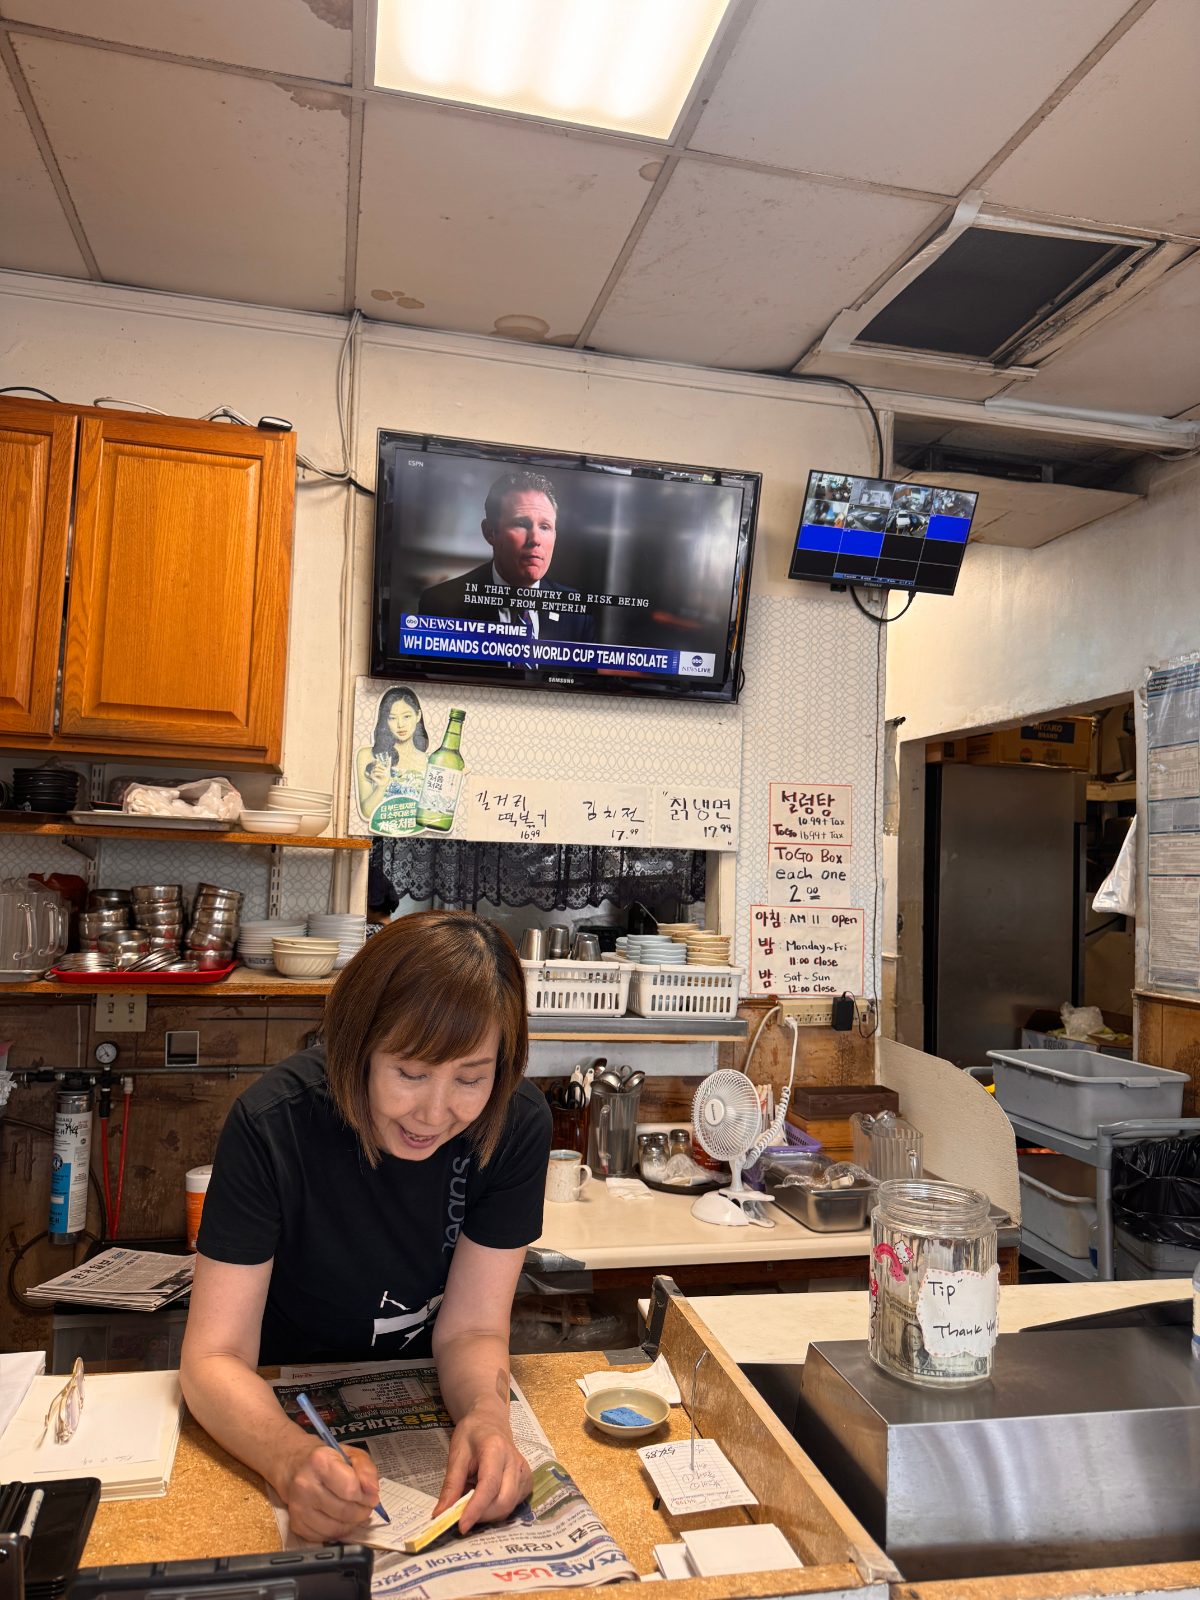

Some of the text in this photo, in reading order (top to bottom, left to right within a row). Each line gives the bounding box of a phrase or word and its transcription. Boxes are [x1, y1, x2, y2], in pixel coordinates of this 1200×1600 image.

[465, 583, 649, 608] IN THAT COUNTRY OR RISK BEING
[464, 595, 587, 614] BANNED FROM ENTERIN
[488, 623, 527, 637] PRIME
[403, 634, 422, 650] WH
[425, 637, 479, 654] DEMANDS
[481, 642, 531, 657] CONGO'S
[532, 645, 570, 661] WORLD
[573, 650, 595, 664] CUP
[597, 651, 625, 666] TEAM
[627, 654, 668, 669] ISOLATE
[548, 676, 574, 685] SAMSUNG
[781, 790, 835, 817] 설렁탕
[583, 800, 644, 822] 김치전
[830, 817, 845, 826] Tax
[829, 831, 844, 839] Tax
[774, 847, 842, 864] ToGo Box
[775, 867, 846, 881] each one
[789, 914, 806, 924] AM
[812, 915, 820, 924] 11
[789, 957, 810, 966] 11:00
[788, 985, 810, 993] 12:00
[933, 1322, 982, 1338] Thank
[493, 1567, 554, 1582] USA
